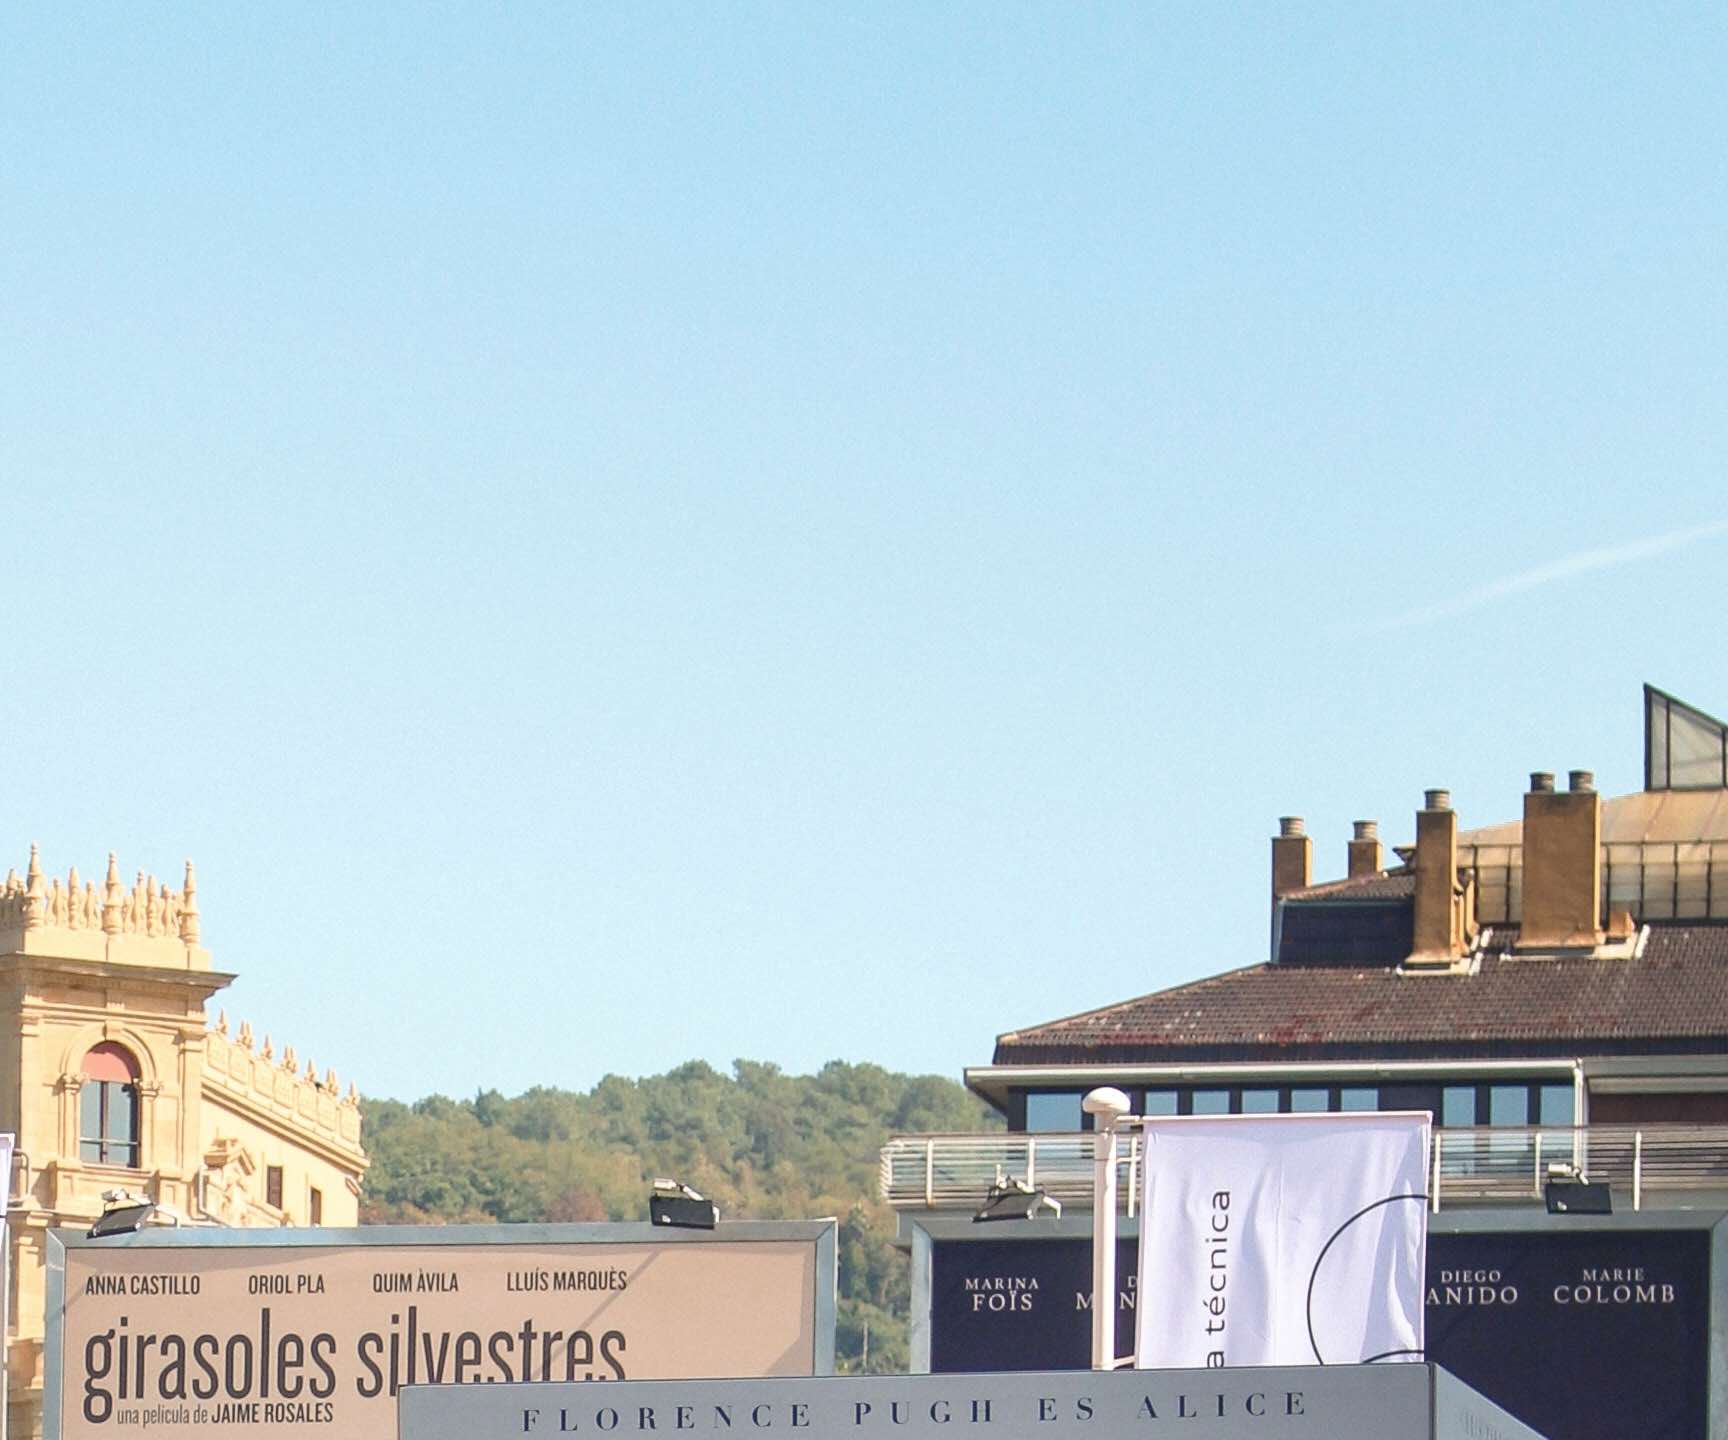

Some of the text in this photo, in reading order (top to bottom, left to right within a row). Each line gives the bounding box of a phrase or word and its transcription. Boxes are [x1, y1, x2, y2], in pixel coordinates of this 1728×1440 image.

[1203, 1190, 1230, 1335] técnica
[85, 1274, 201, 1296] ANNA CASTILLO
[248, 1274, 325, 1295] ORIOL PLA
[372, 1268, 459, 1293] QUIM ÀVILA
[506, 1266, 628, 1292] LLUÍS MARQUÈS
[965, 1277, 1039, 1291] MARINA
[1441, 1270, 1501, 1284] DIEGO
[1583, 1268, 1645, 1282] MARIE
[972, 1289, 1033, 1312] FOÏS
[1426, 1286, 1518, 1305] ANIDO
[1553, 1284, 1675, 1304] COLOMB
[83, 1306, 627, 1424] girasoles silvestres
[117, 1409, 140, 1425] una
[193, 1403, 208, 1424] de
[211, 1402, 261, 1424] JAIME
[264, 1402, 334, 1424] ROSALES
[521, 1390, 1307, 1432] FLORENCE PUGH ES ALICE
